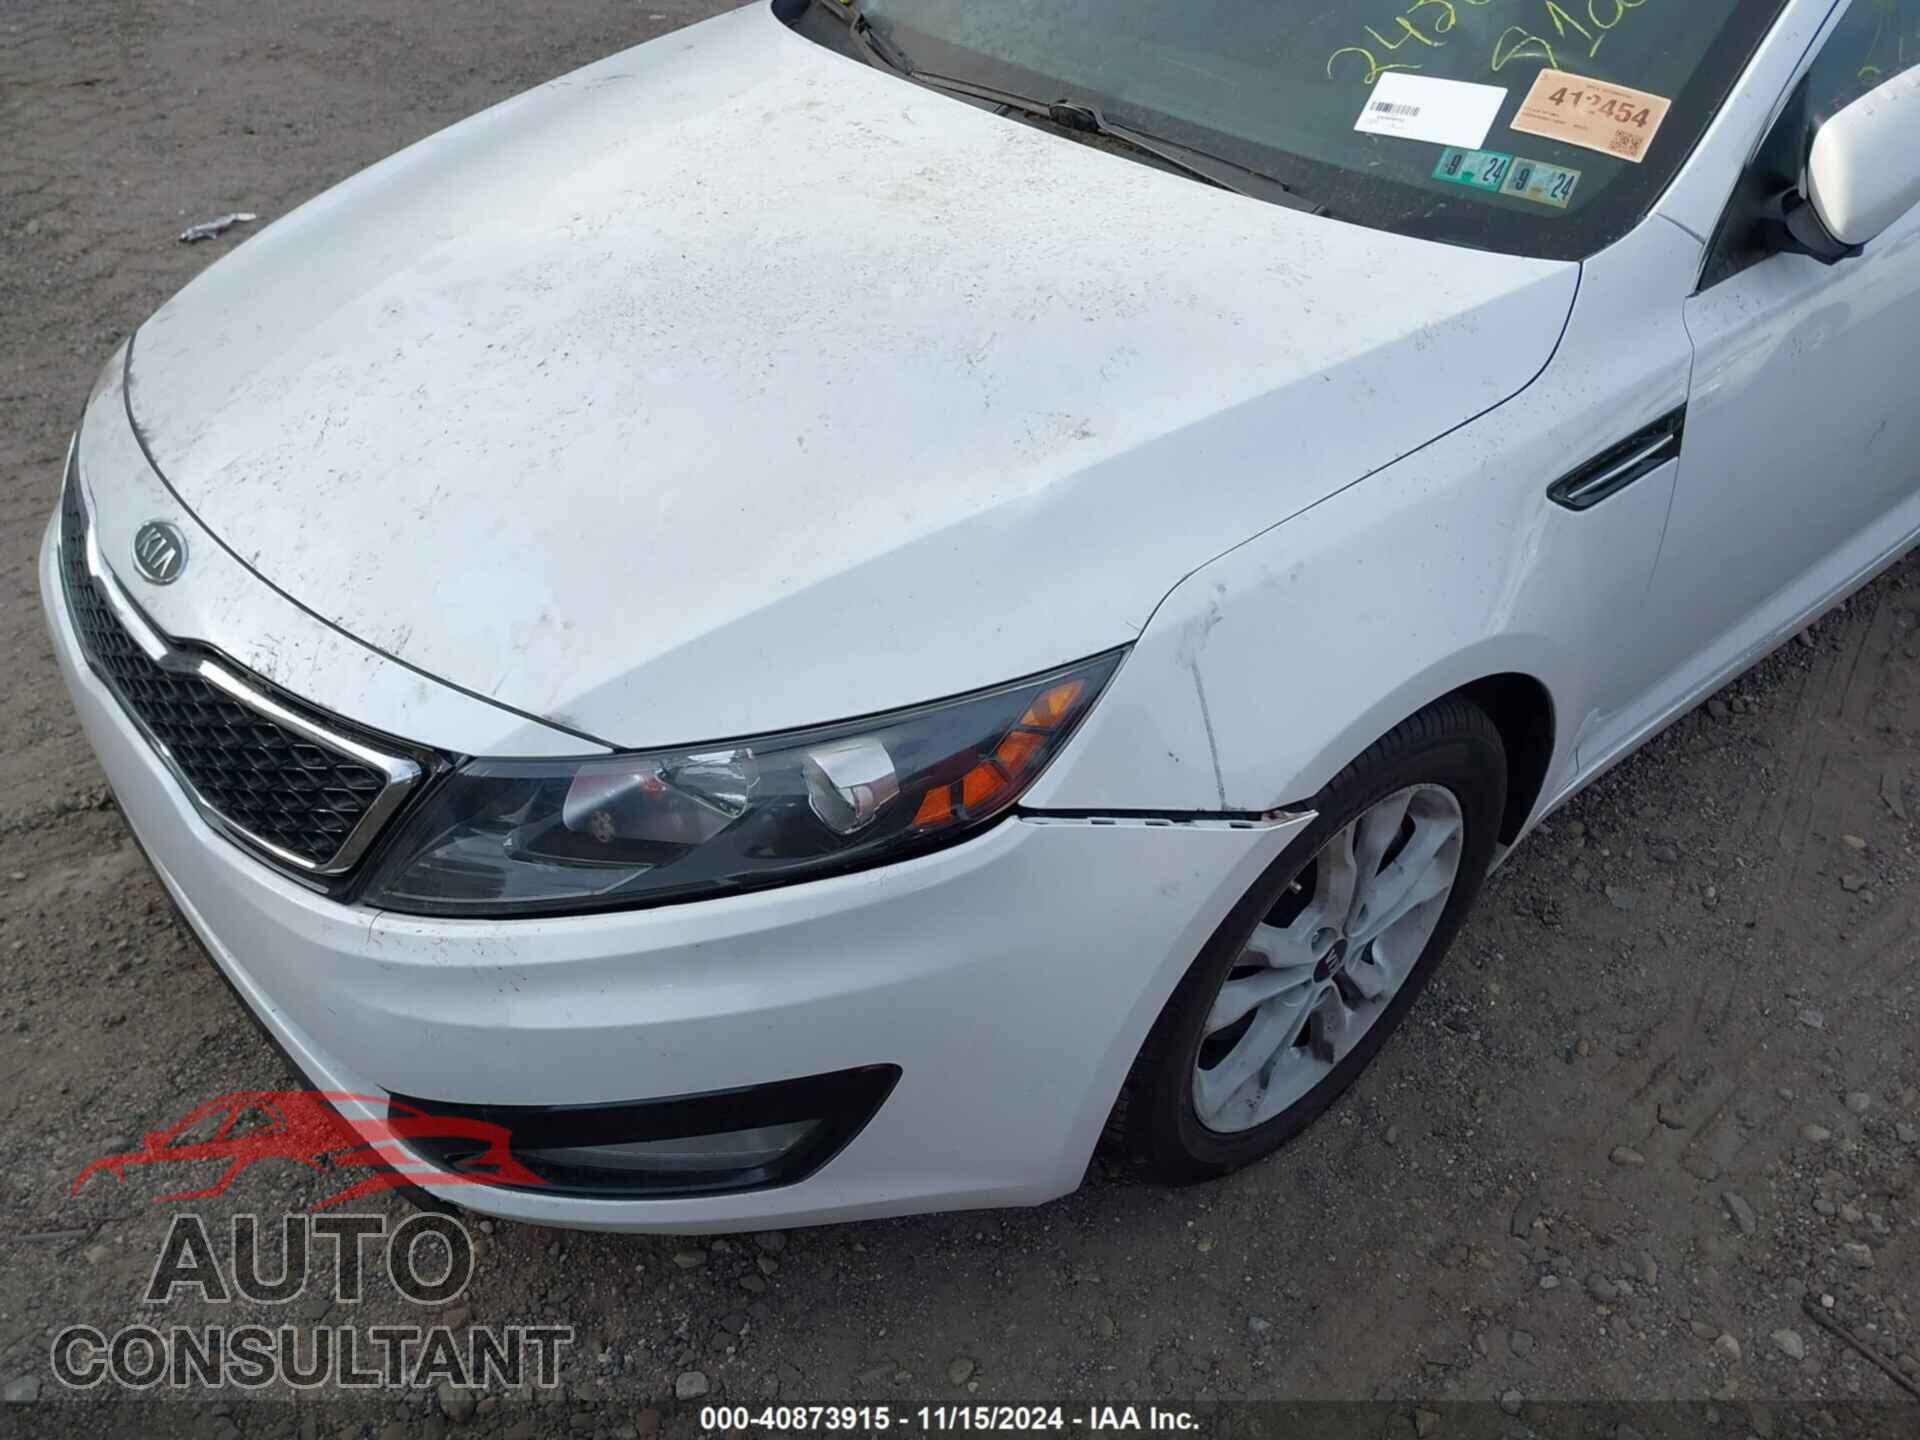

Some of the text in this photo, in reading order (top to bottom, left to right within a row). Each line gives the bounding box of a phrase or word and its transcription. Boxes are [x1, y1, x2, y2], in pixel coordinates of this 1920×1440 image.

[1482, 157, 1506, 184] 24
[1550, 173, 1576, 200] 24
[137, 527, 177, 577] KIA
